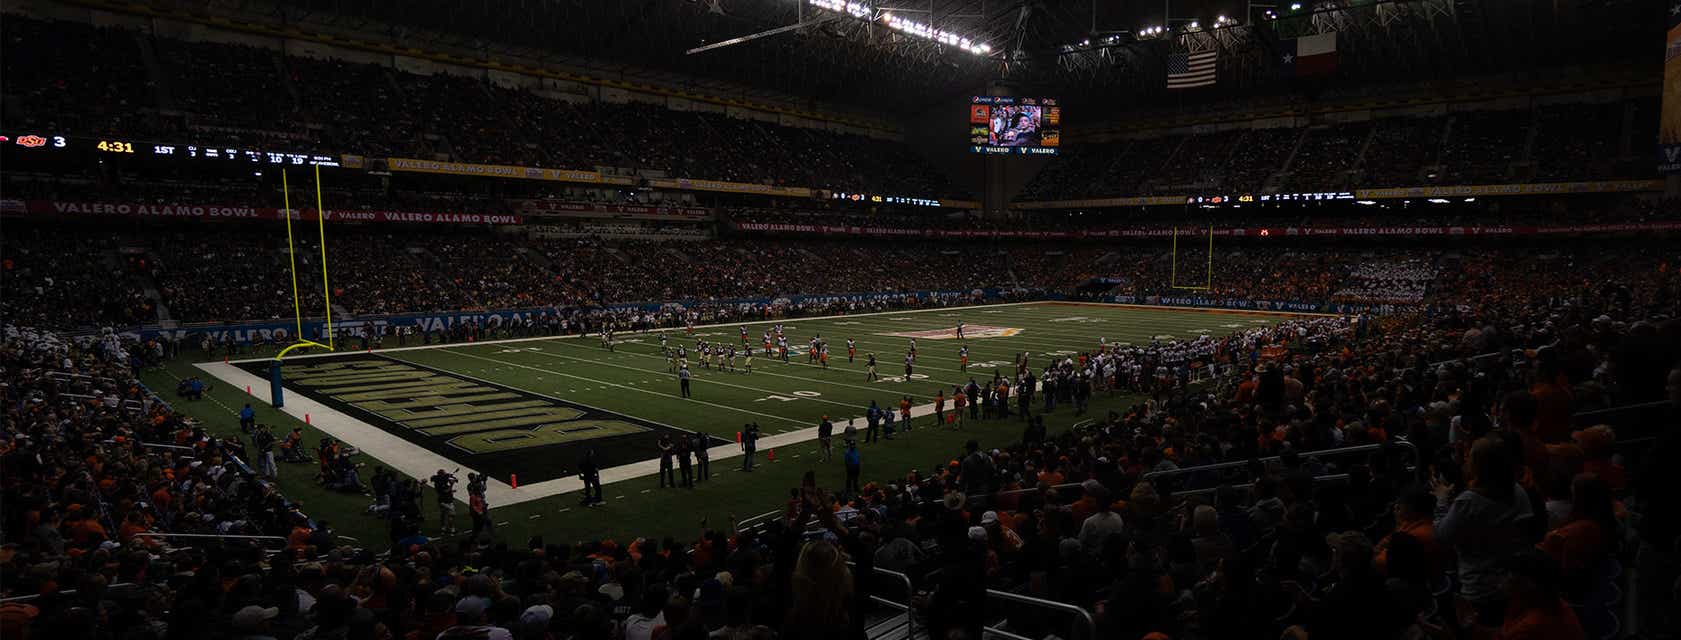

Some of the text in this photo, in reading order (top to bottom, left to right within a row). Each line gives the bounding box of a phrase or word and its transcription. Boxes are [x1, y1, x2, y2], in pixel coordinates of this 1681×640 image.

[53, 136, 66, 148] 3
[97, 140, 134, 153] 4:31
[154, 145, 175, 155] 1ST
[54, 201, 260, 218] VALERO ALAMO BOWL
[338, 211, 376, 221] VALERO
[384, 211, 433, 223] VALERO
[436, 213, 480, 224] ALAMO
[483, 214, 518, 225] BOWL
[1343, 227, 1376, 235] VALERO
[1378, 227, 1412, 235] ALAMO
[283, 356, 655, 455] BUFFALOES
